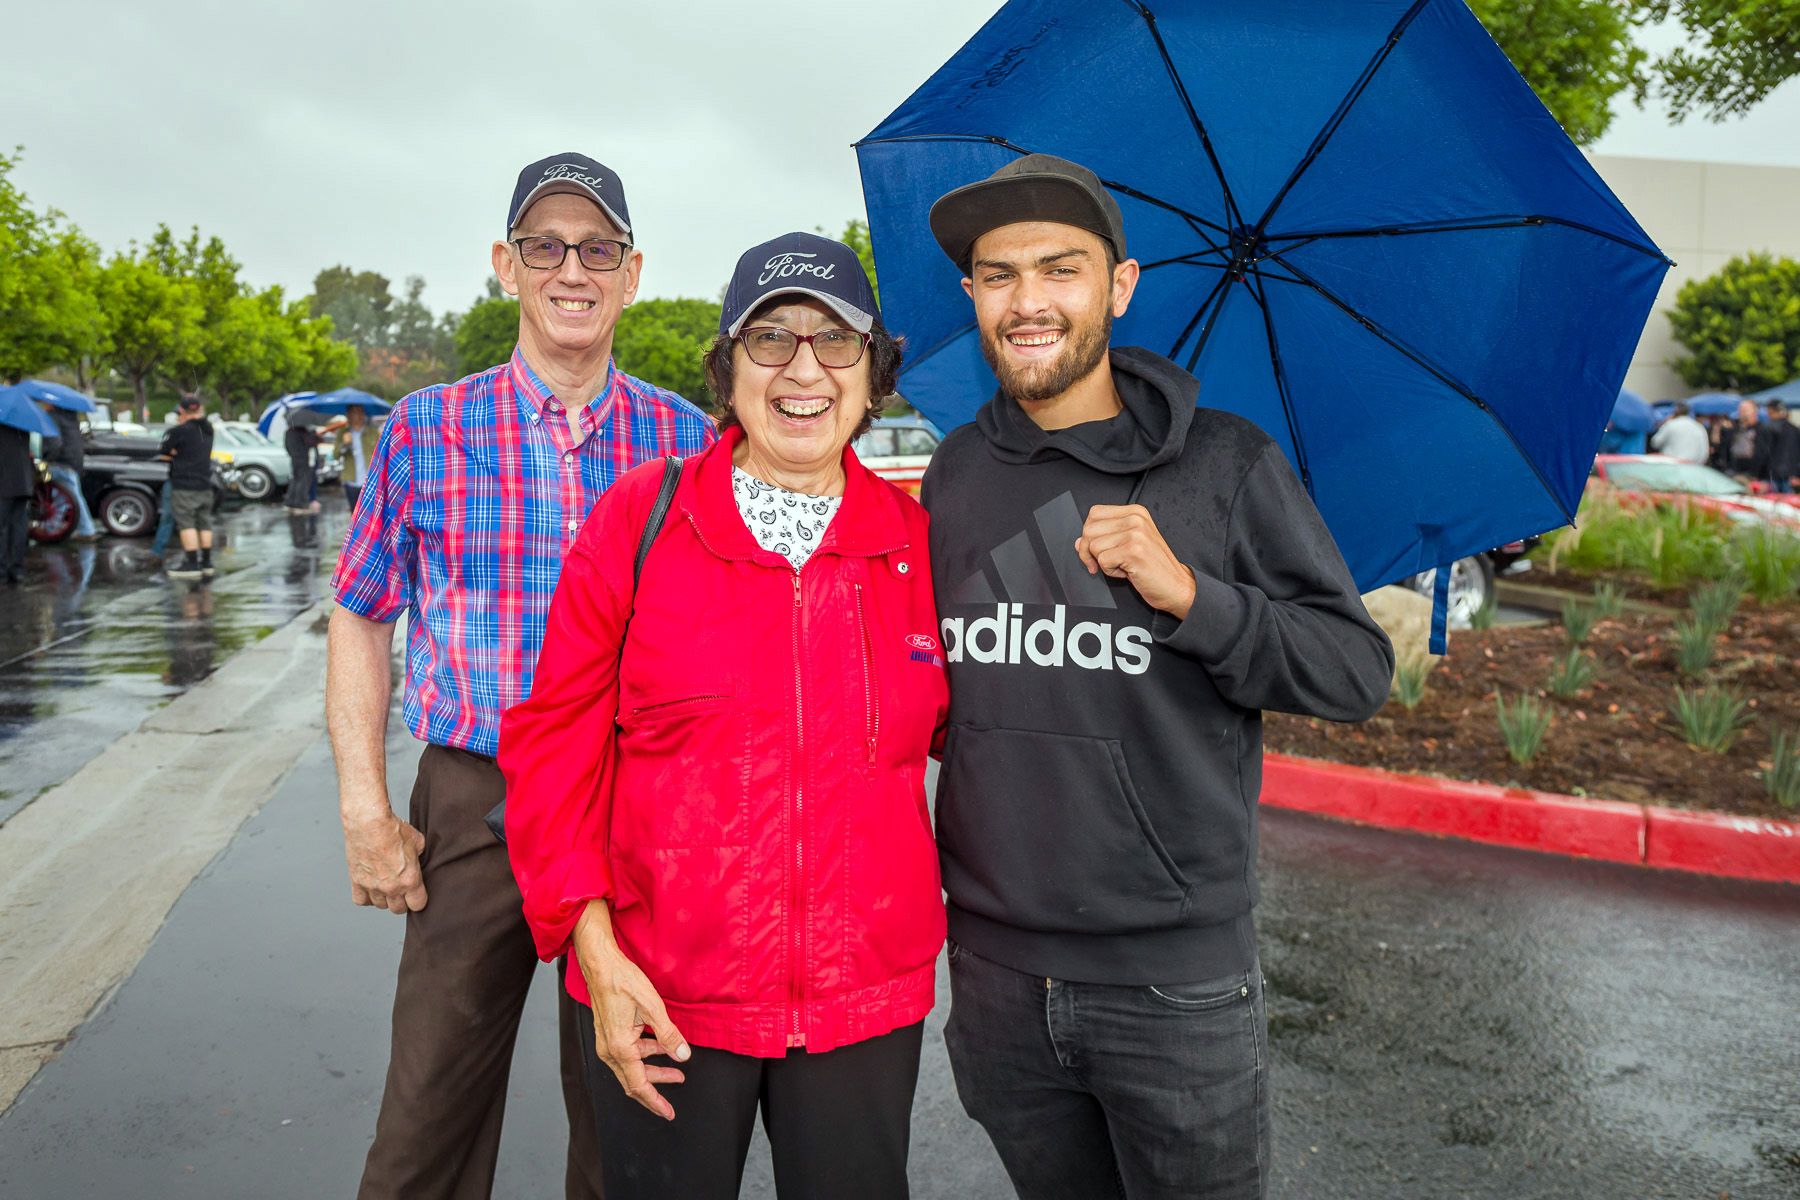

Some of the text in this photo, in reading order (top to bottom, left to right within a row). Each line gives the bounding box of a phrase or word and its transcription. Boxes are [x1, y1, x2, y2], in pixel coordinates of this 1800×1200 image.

[537, 163, 603, 188] Ford
[757, 252, 836, 286] Ford
[911, 634, 933, 648] Ford
[941, 602, 1153, 675] adidas
